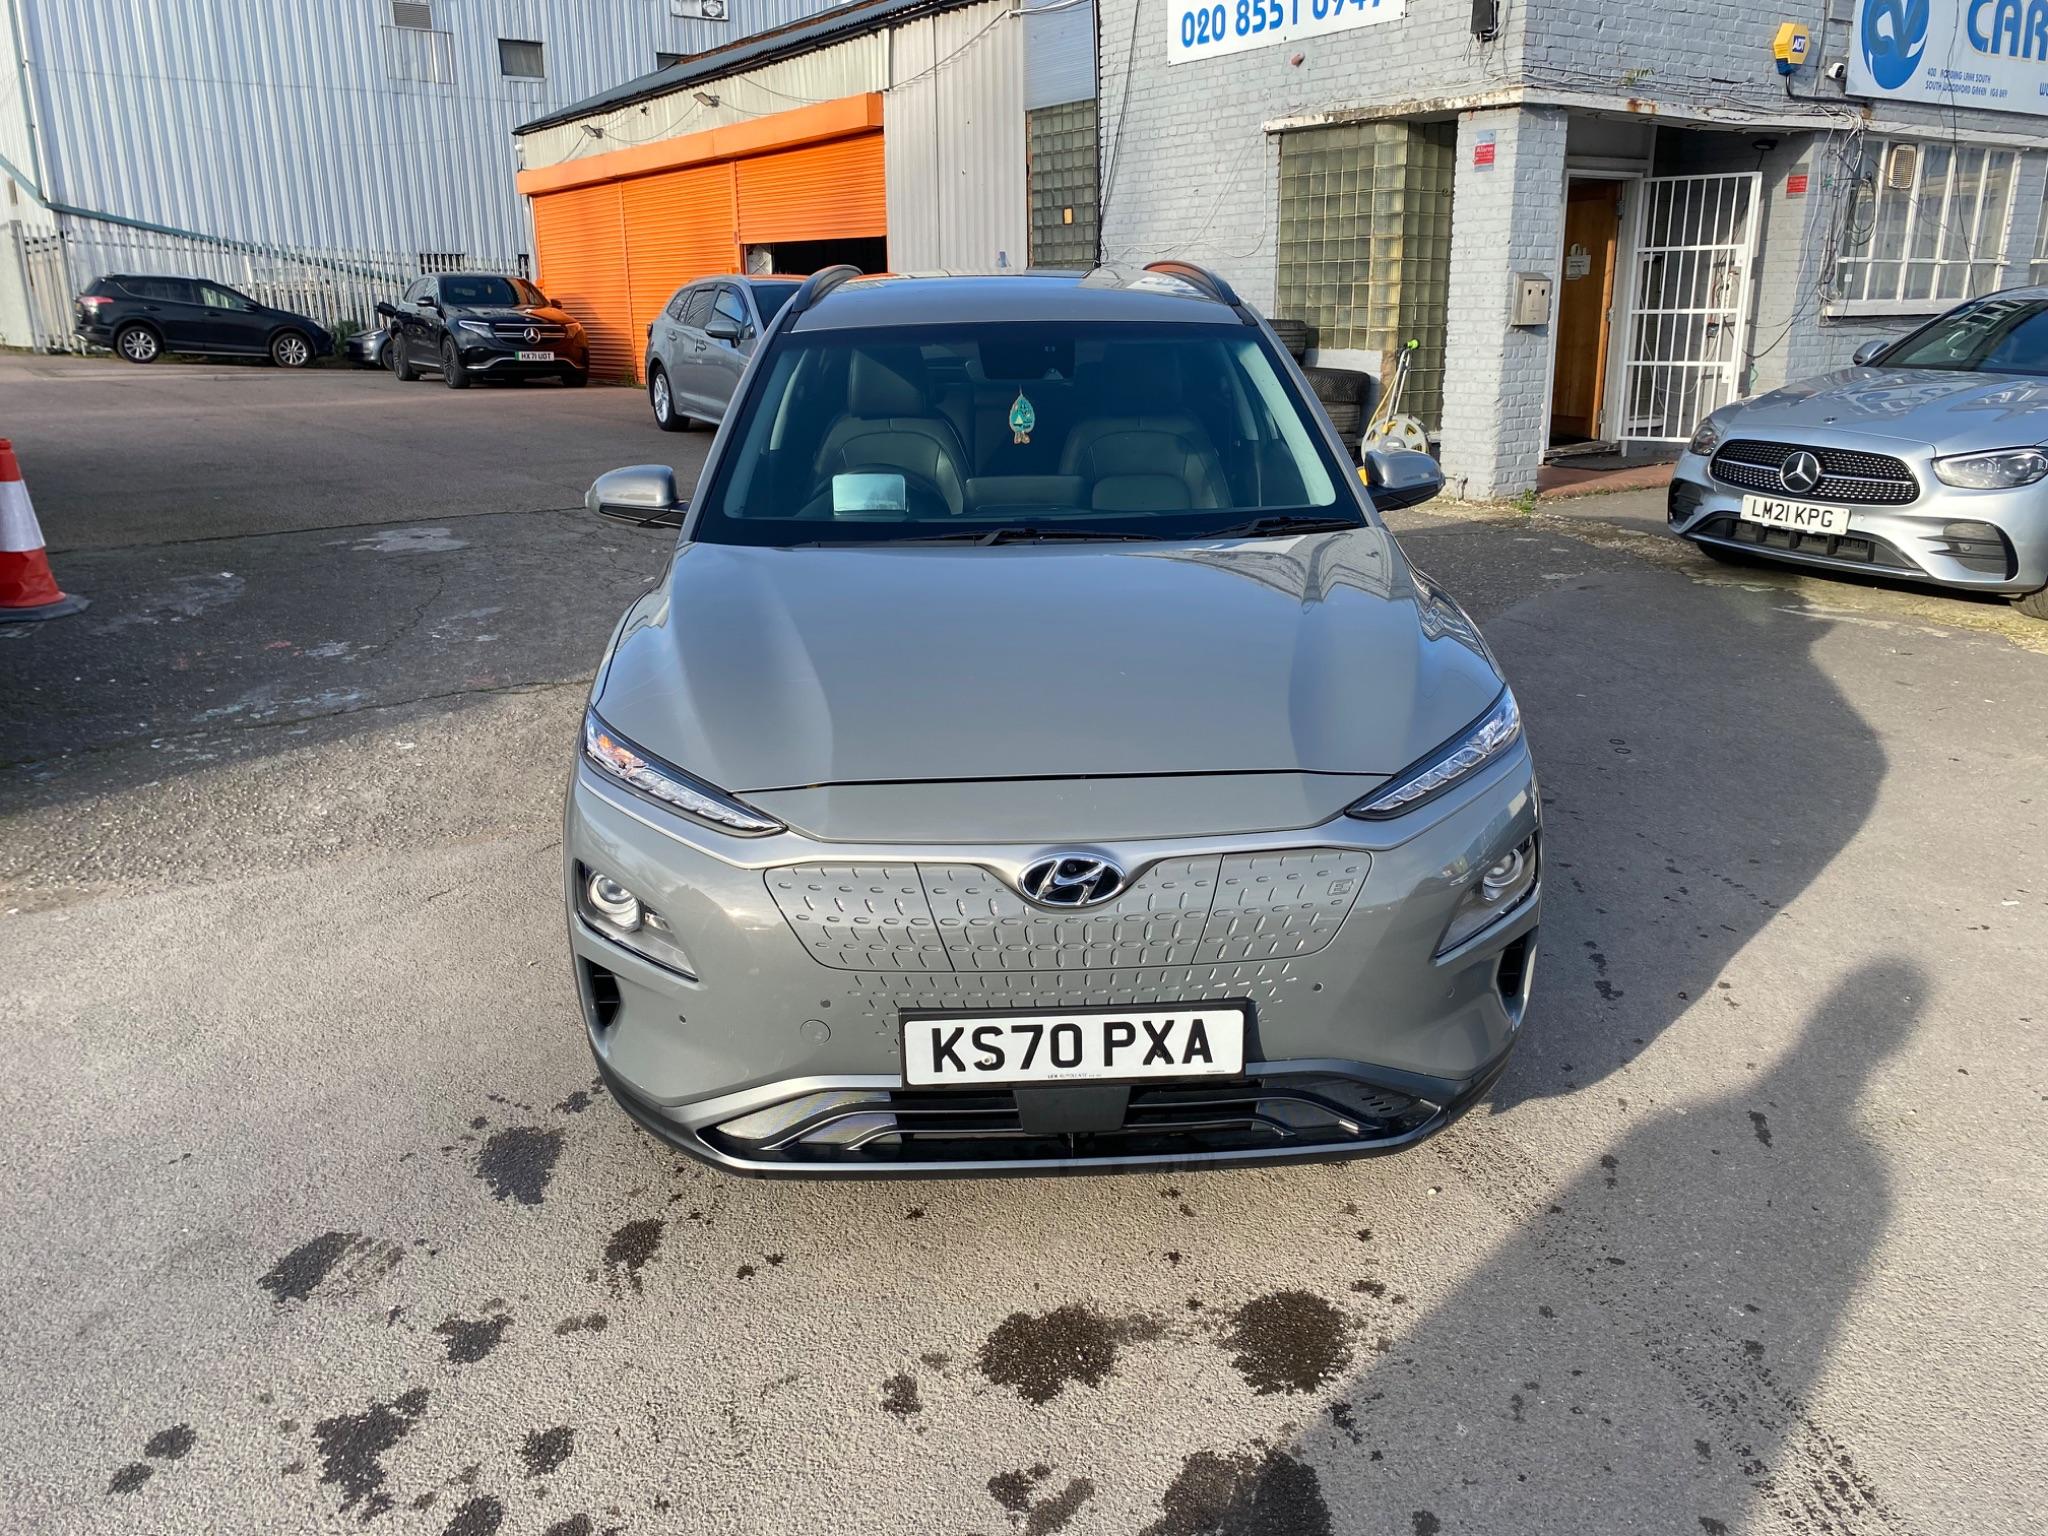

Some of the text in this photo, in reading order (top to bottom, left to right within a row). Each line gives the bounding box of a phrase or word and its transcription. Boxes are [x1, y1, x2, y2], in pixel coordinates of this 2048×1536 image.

[1181, 4, 1226, 48] 020
[1235, 0, 1298, 36] 8551
[1925, 80, 1941, 91] SOUTH
[1971, 86, 1987, 97] GREEN
[1975, 73, 1991, 83] SOUTH
[1751, 499, 1834, 528] LM21 KPG
[931, 1019, 1214, 1073] KS70 PXA
